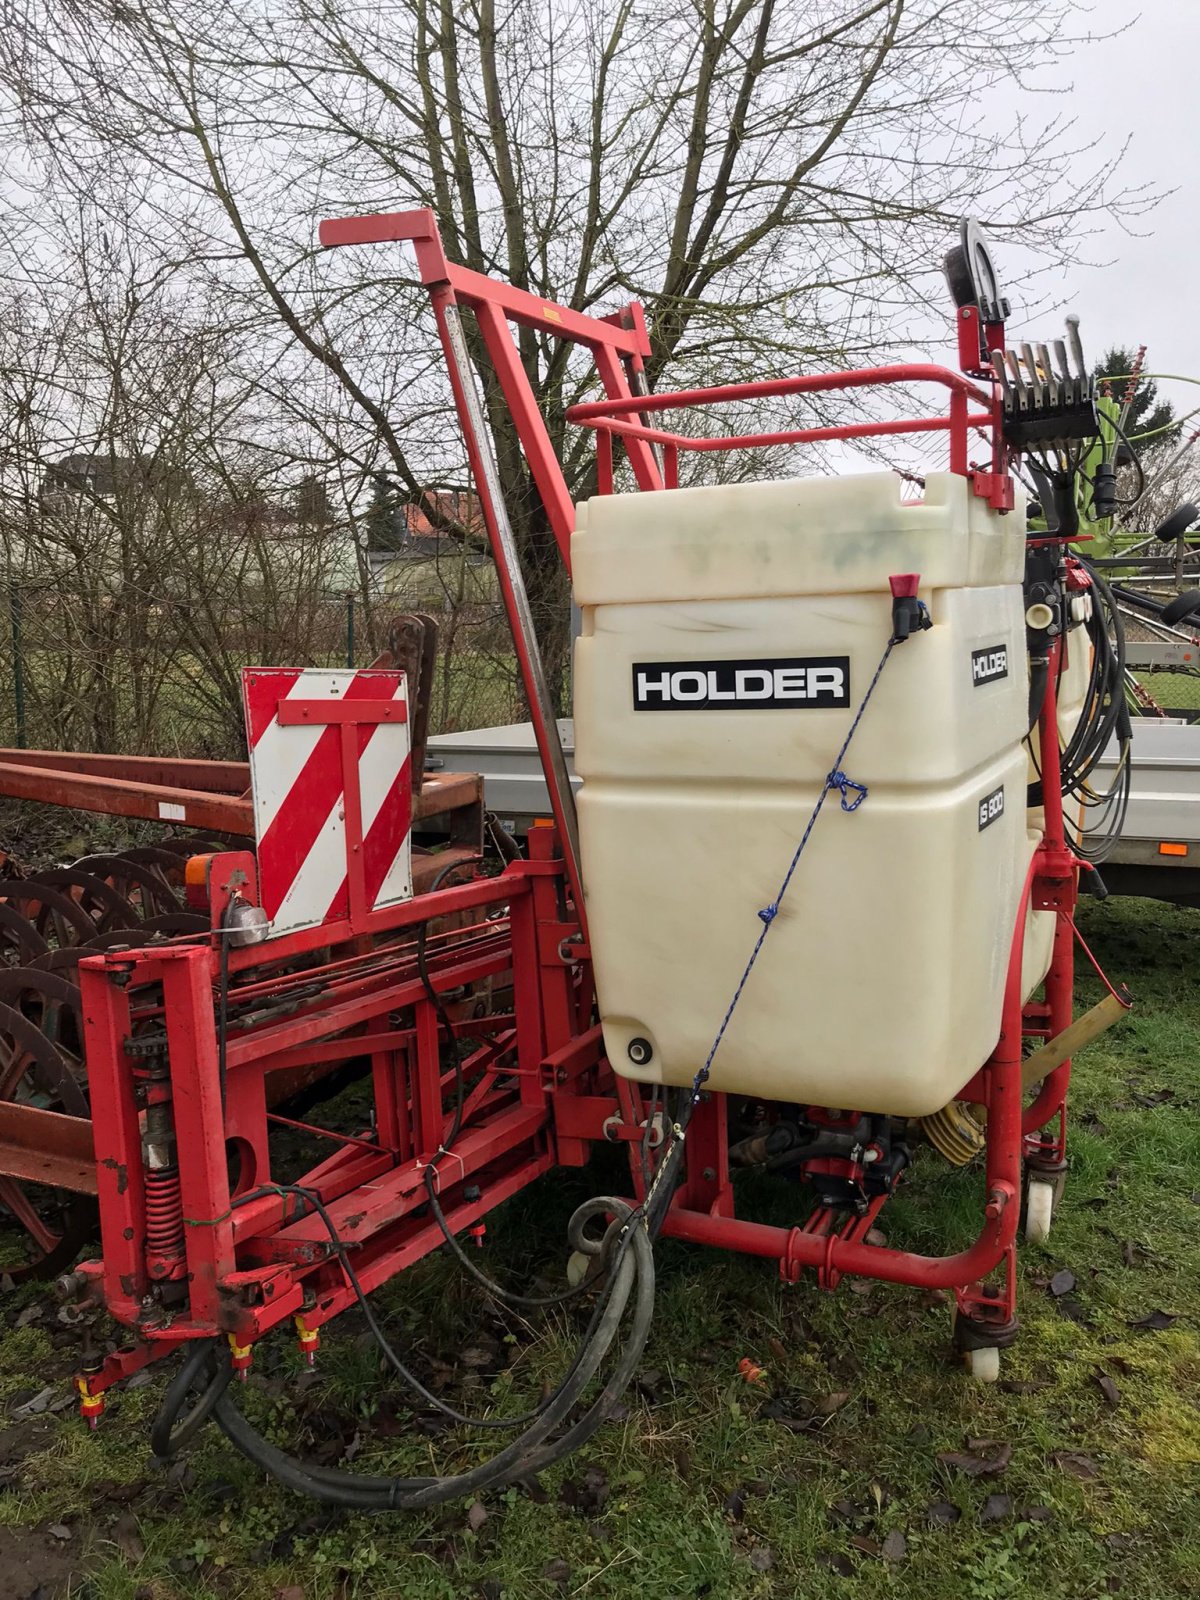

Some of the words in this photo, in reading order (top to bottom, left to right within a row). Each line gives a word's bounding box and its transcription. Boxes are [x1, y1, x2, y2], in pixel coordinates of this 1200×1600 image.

[972, 651, 1006, 680] HOLDER
[637, 667, 844, 701] HOLDER
[988, 791, 1003, 818] 800
